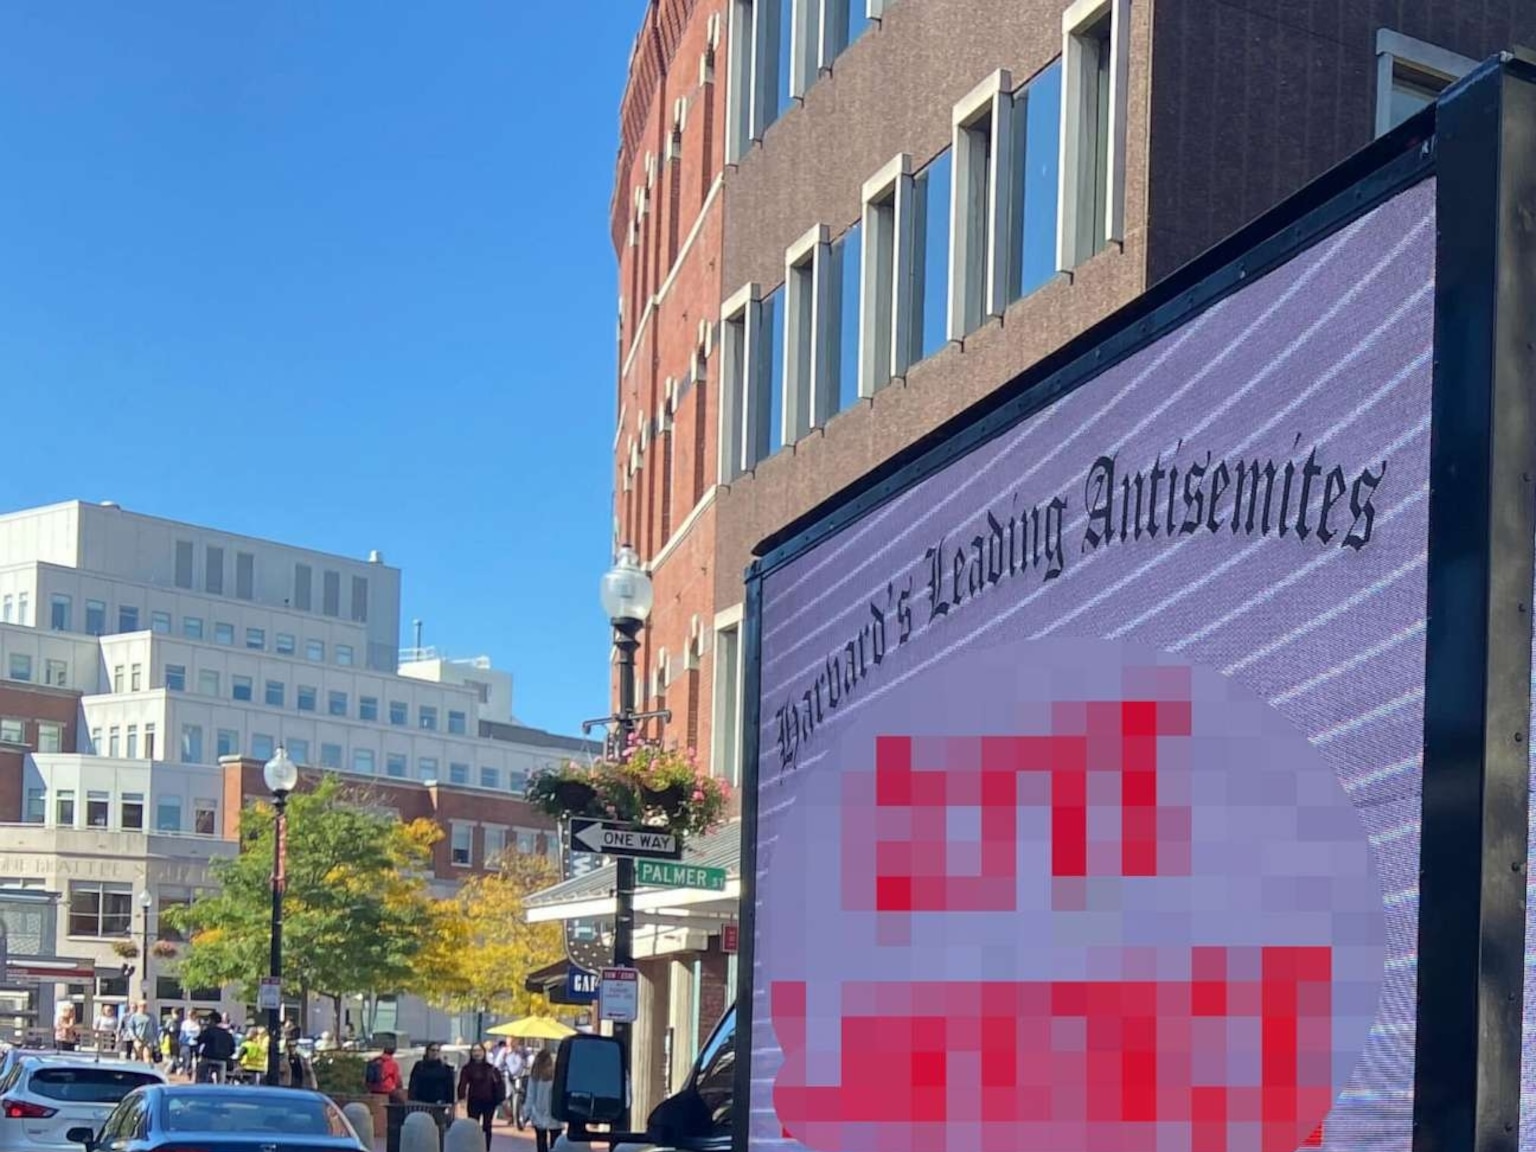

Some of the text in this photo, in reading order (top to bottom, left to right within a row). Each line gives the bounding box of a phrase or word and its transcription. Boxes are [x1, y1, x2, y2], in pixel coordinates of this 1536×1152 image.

[775, 431, 1388, 770] Harvard's Leading Antisemites
[603, 831, 671, 849] ONE WAY
[642, 863, 724, 887] PALMER ST
